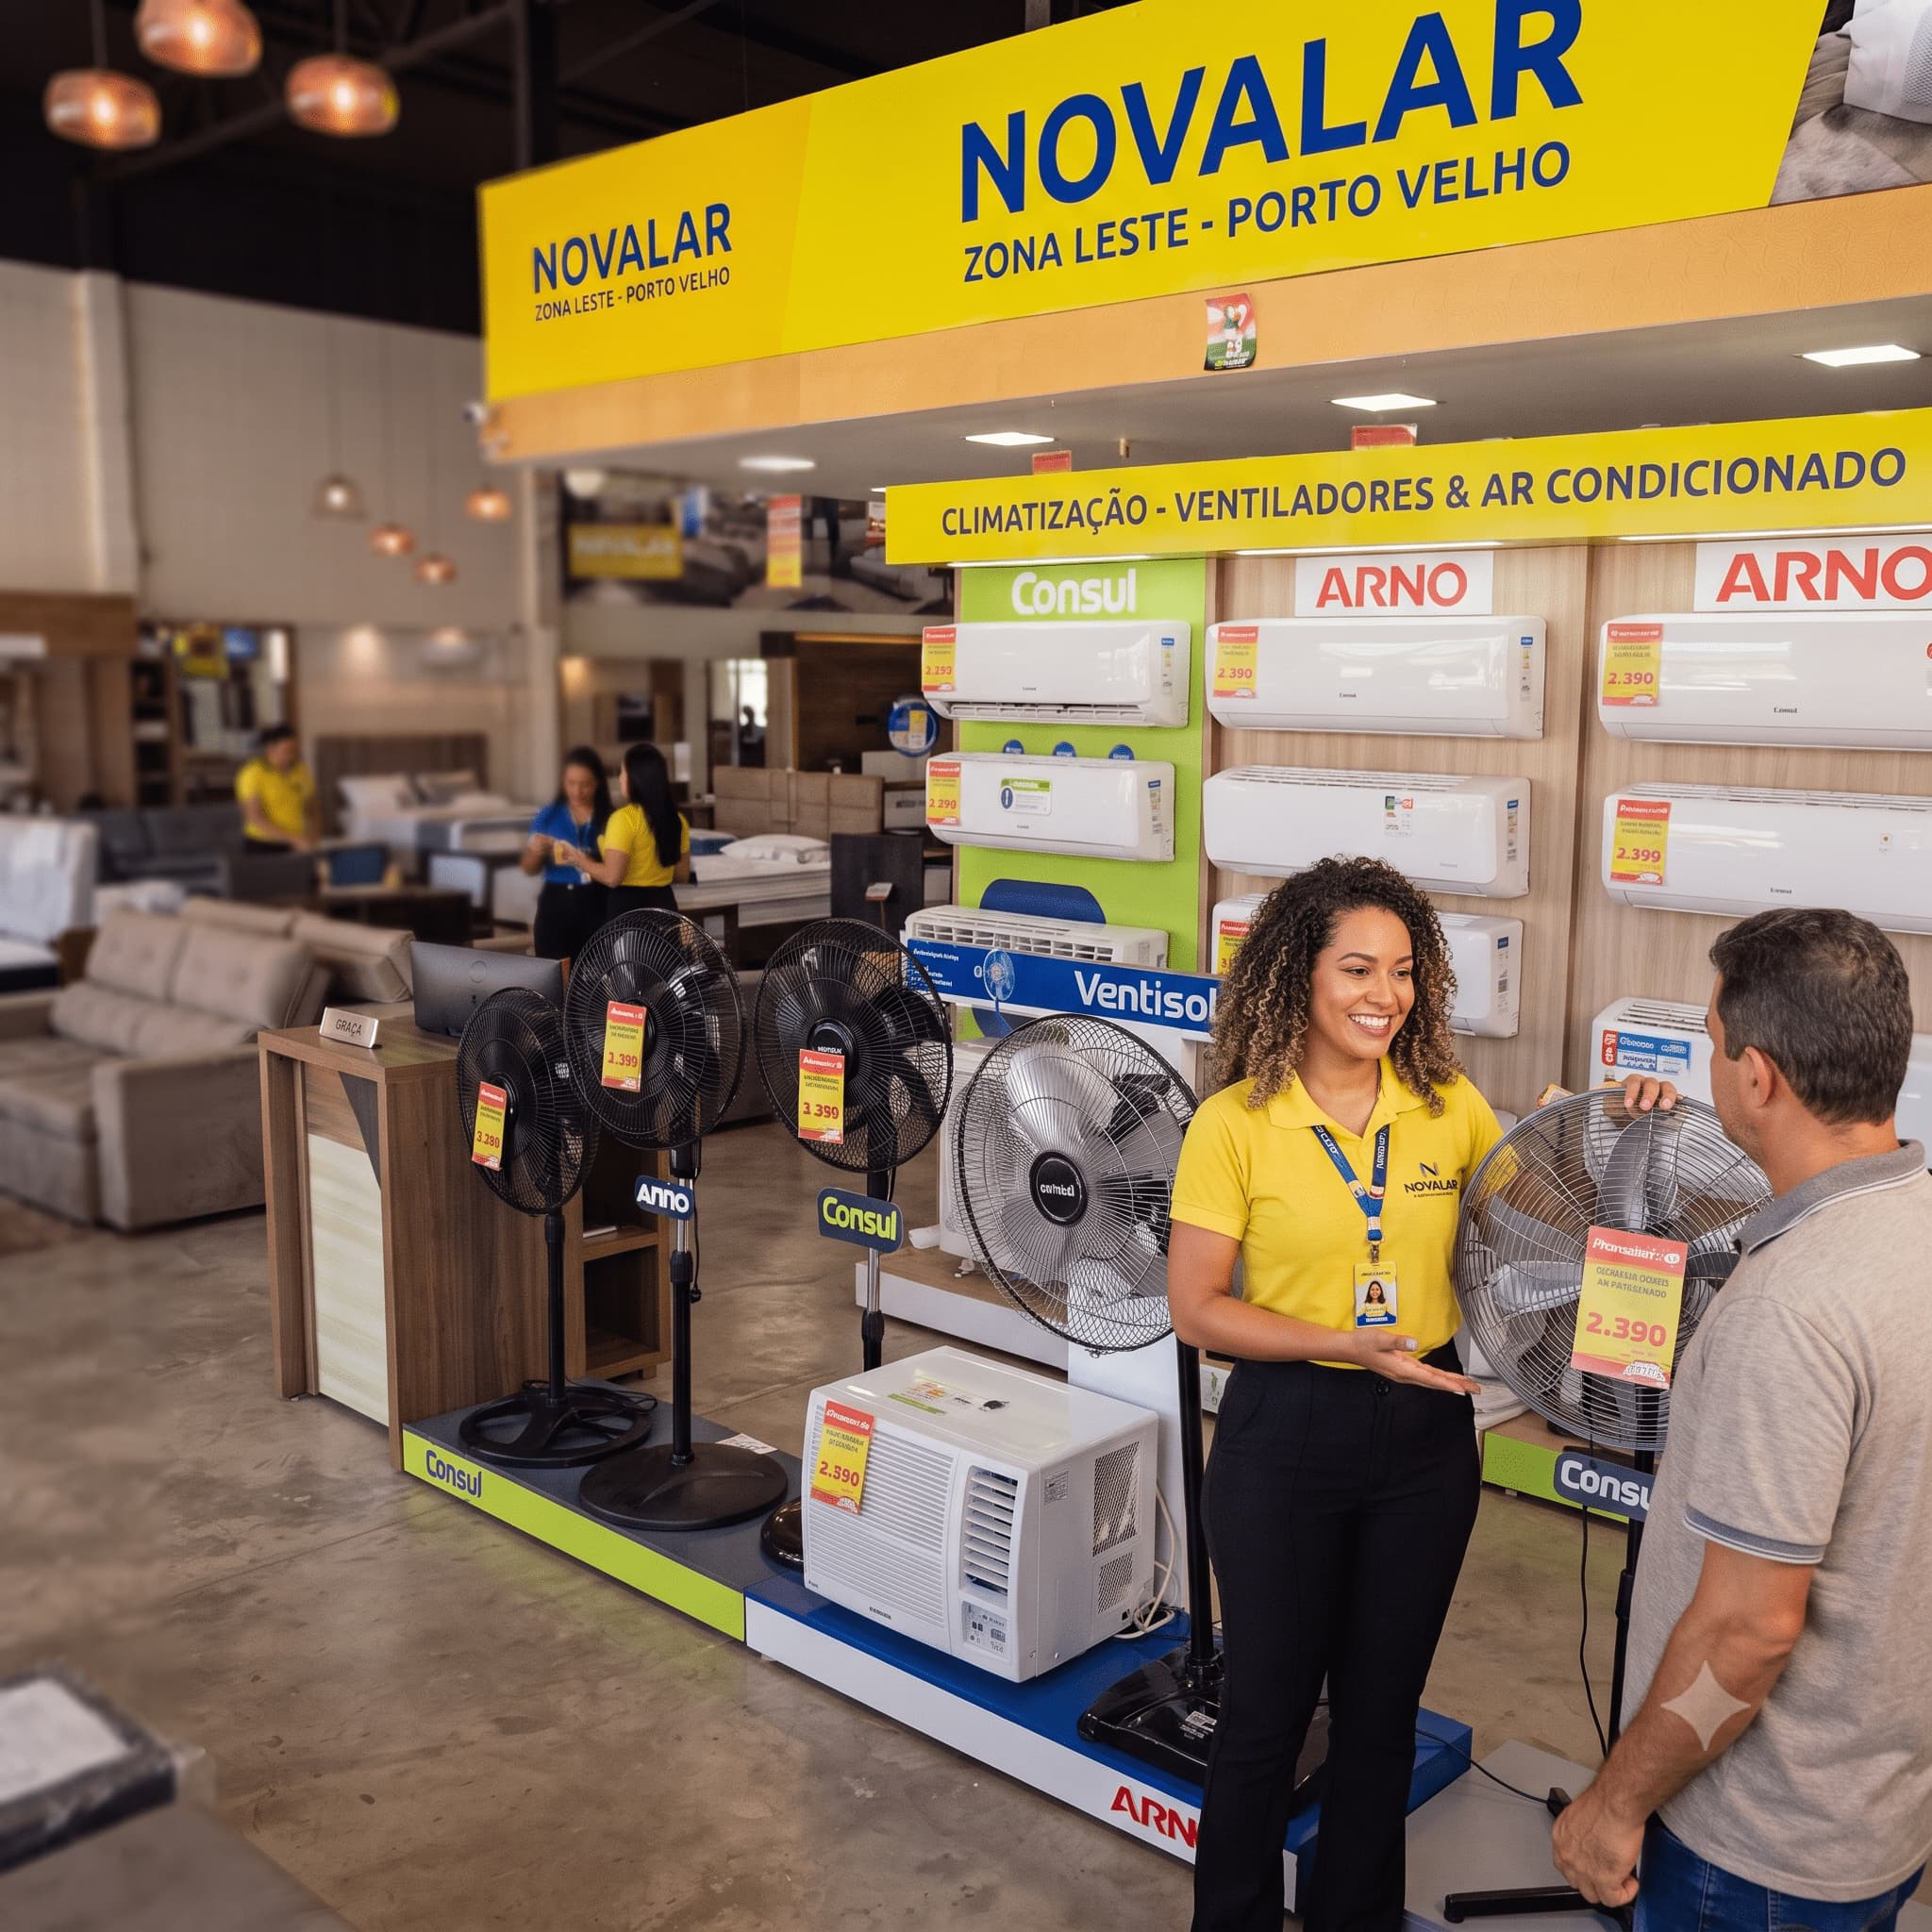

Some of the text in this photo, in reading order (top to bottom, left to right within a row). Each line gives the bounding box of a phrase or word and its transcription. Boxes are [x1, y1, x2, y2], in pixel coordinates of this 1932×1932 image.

[962, 0, 1582, 223] NOVALAR
[965, 233, 1063, 282] ZONA
[1075, 208, 1188, 263] LESTE
[1228, 175, 1382, 237] PORTO
[1397, 142, 1570, 208] VELHO
[533, 203, 732, 293] NOVALAR
[535, 297, 572, 322] ZONA
[575, 291, 614, 314] LESTE
[626, 277, 675, 305] PORTO
[679, 266, 730, 294] VELHO
[941, 488, 1148, 535] CLIMATIZAÇÃO
[1175, 476, 1434, 522] VENTILADORES
[1445, 475, 1470, 508] &
[1481, 471, 1534, 507] AR
[1546, 447, 1907, 504] CONDICIONADO
[1011, 568, 1137, 615] Consul
[1316, 561, 1468, 608] ARNO
[1716, 545, 1932, 603] ARNO
[1607, 672, 1654, 685] 2.390
[1616, 847, 1661, 863] 2.399
[1074, 970, 1217, 1022] Ventisol
[335, 1019, 362, 1036] GRAÇA
[1404, 1179, 1458, 1193] NOVALAR
[823, 1196, 896, 1241] Consul
[1586, 1311, 1667, 1347] 2.390
[425, 1449, 482, 1498] Consul
[1560, 1459, 1653, 1511] Consu
[1110, 1786, 1197, 1849] ARN
